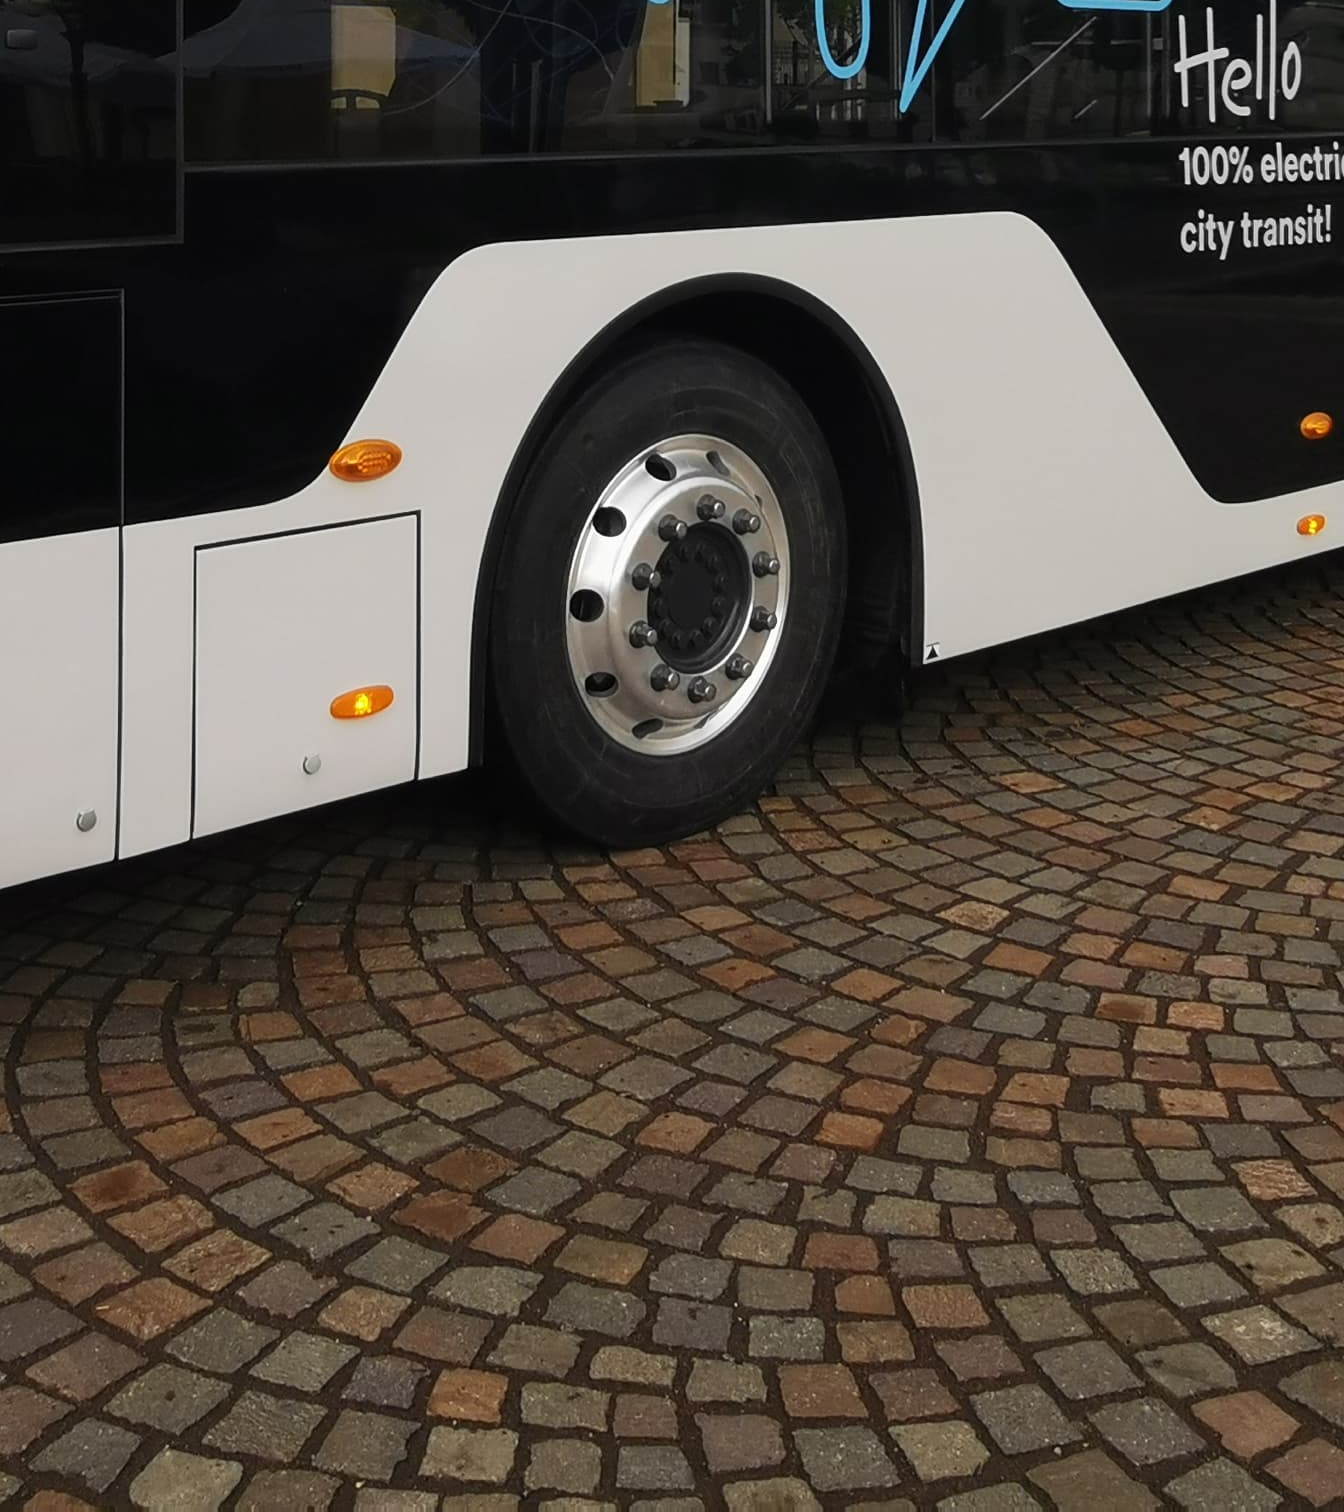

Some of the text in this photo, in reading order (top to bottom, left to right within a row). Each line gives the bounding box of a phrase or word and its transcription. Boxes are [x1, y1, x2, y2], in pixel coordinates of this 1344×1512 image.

[1178, 145, 1254, 186] 100%
[1179, 203, 1332, 261] city transit!
